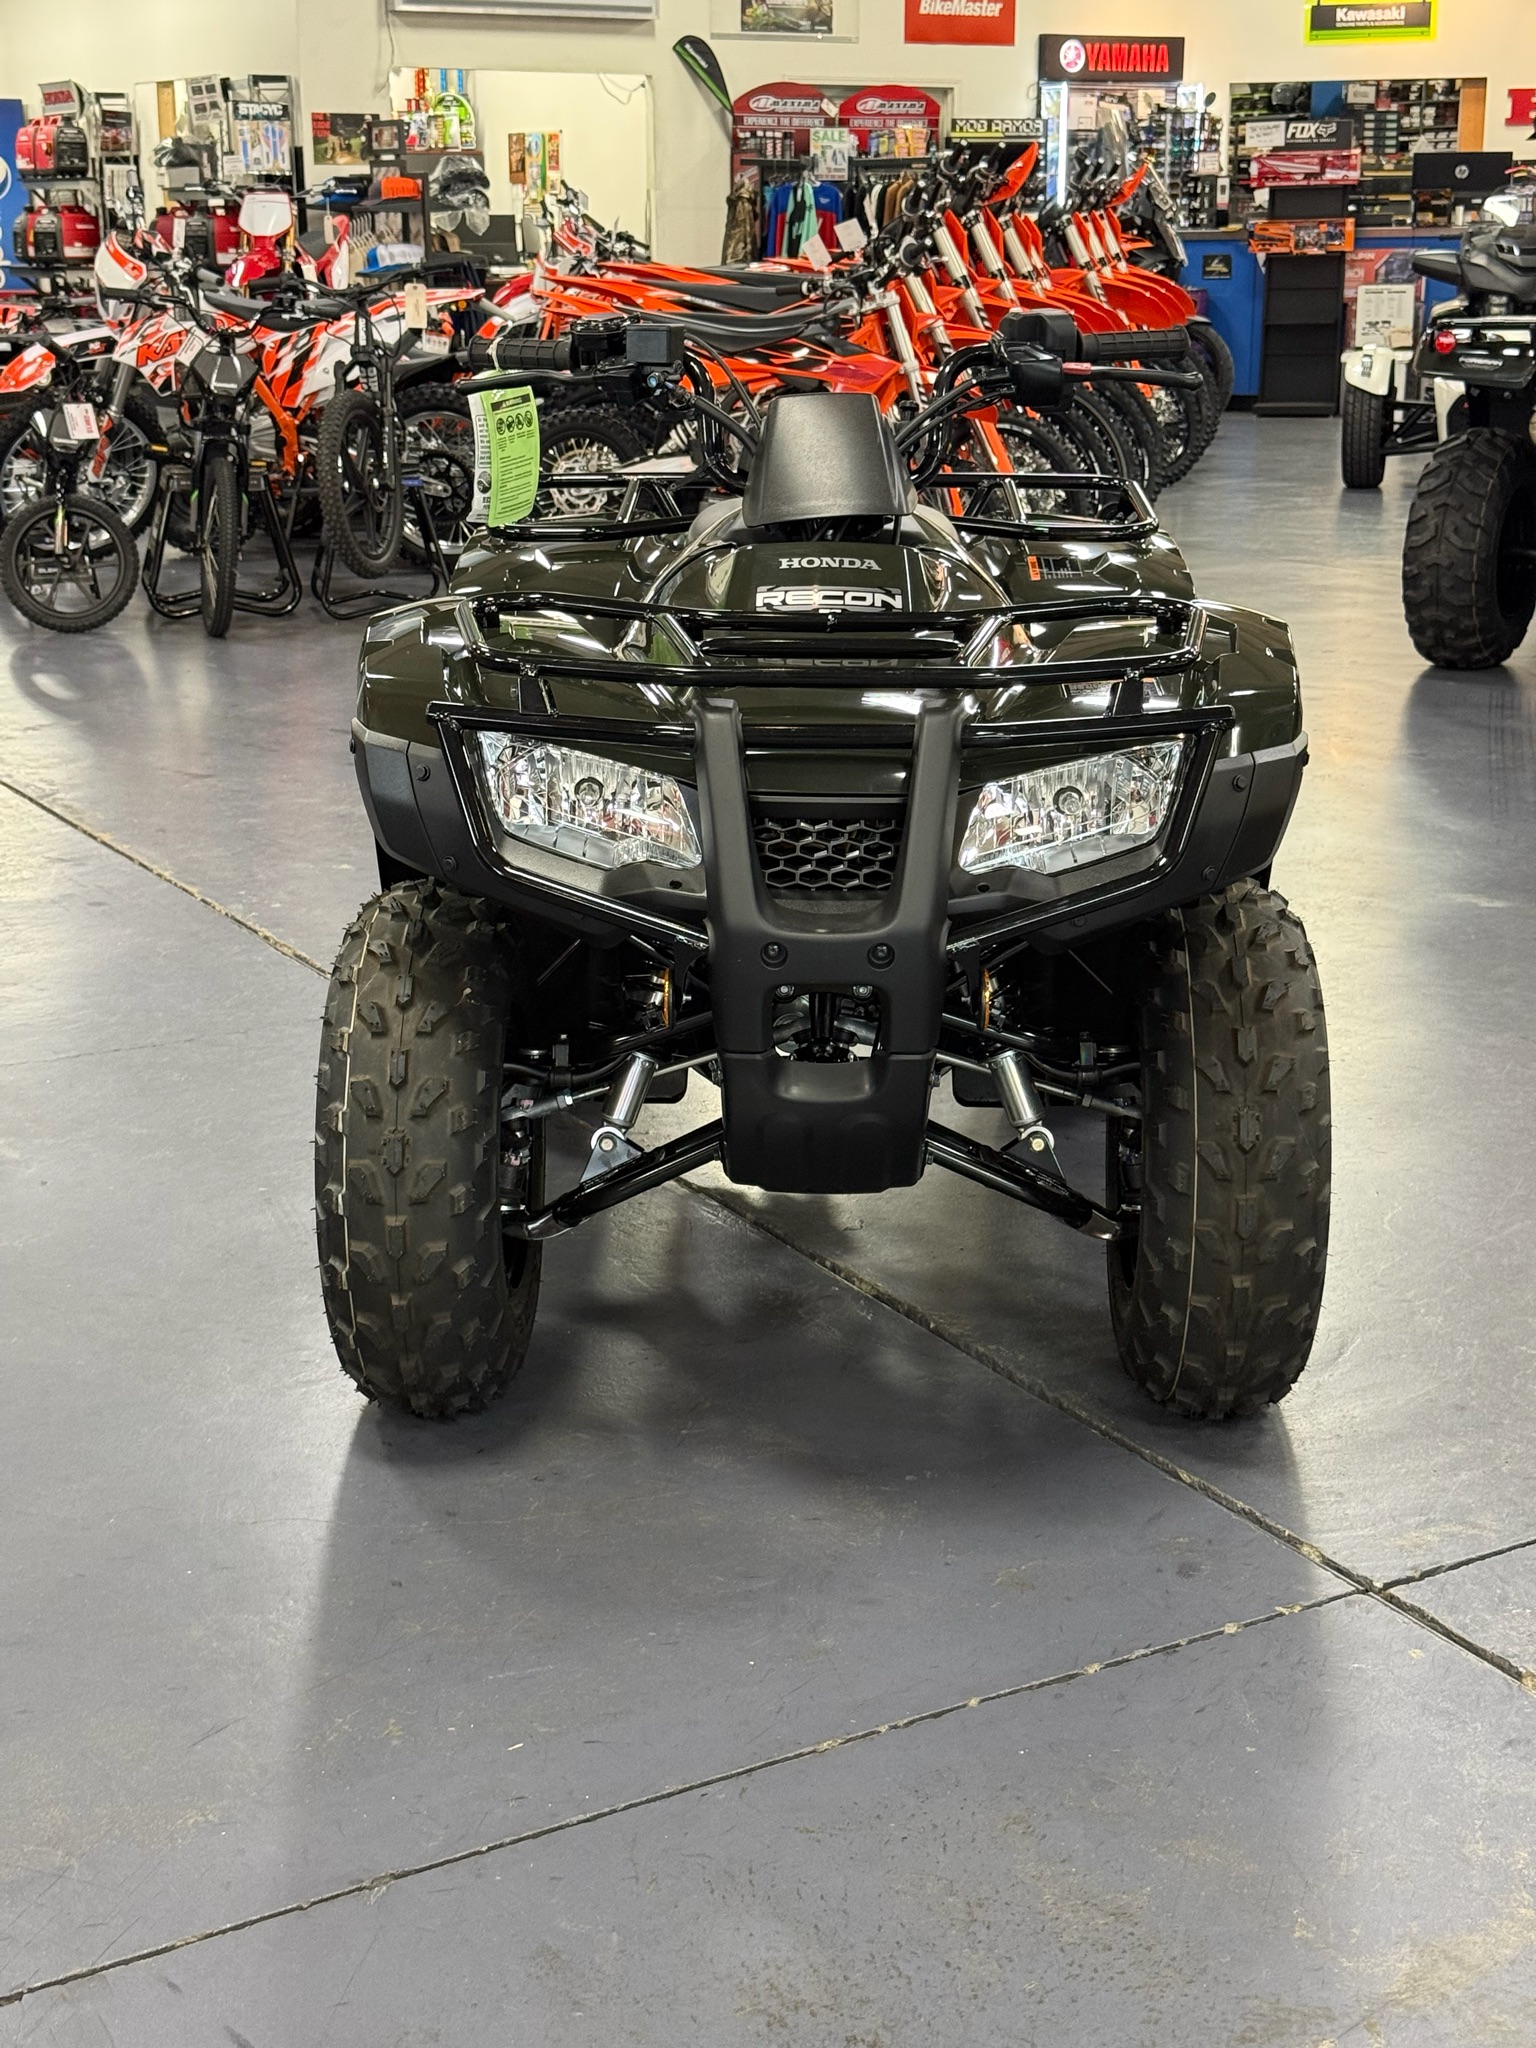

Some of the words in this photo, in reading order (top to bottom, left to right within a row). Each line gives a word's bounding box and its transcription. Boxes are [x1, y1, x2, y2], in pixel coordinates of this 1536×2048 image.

[919, 0, 1003, 17] BikeMaster
[1335, 6, 1406, 22] Kawasaki
[1085, 42, 1169, 72] YAMAHA
[238, 103, 283, 116] STACYC
[769, 100, 819, 108] MAXIMA
[956, 120, 987, 132] MOB
[991, 120, 1043, 133] ARMOR
[1286, 122, 1319, 139] FOX
[813, 130, 845, 142] SALE
[779, 557, 882, 571] HONDA
[756, 590, 902, 609] RECON
